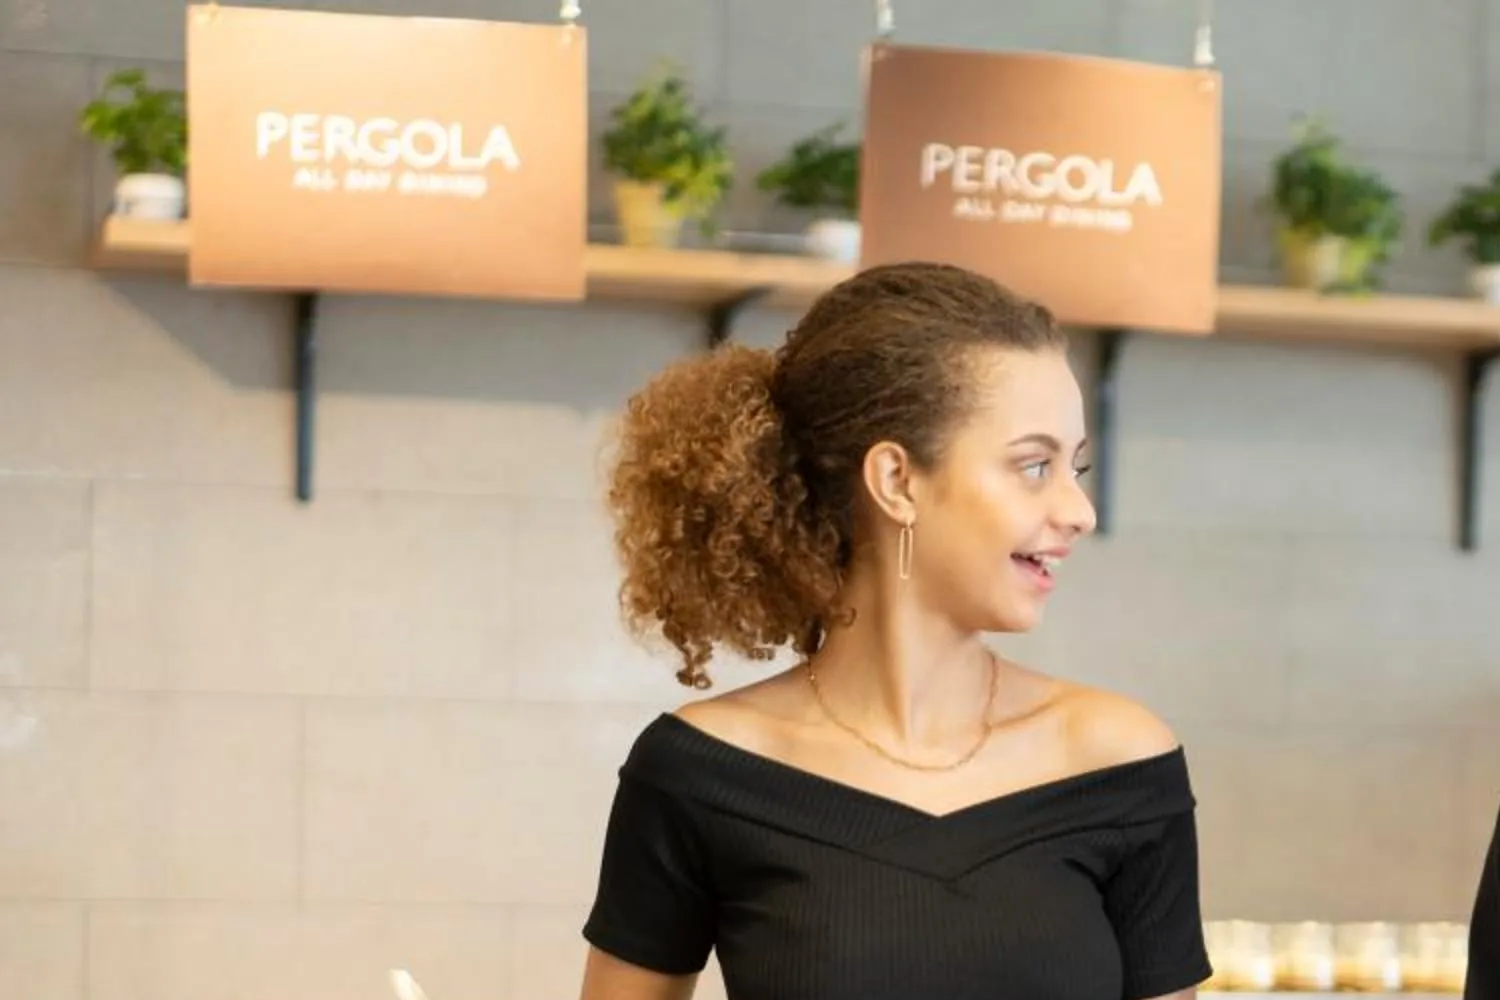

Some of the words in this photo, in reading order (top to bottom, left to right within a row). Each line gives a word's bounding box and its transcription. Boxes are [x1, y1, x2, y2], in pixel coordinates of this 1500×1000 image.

[256, 111, 520, 171] PERGOLA
[292, 167, 338, 191] ALL
[920, 142, 1163, 207] PERGOLA
[953, 196, 995, 221] ALL
